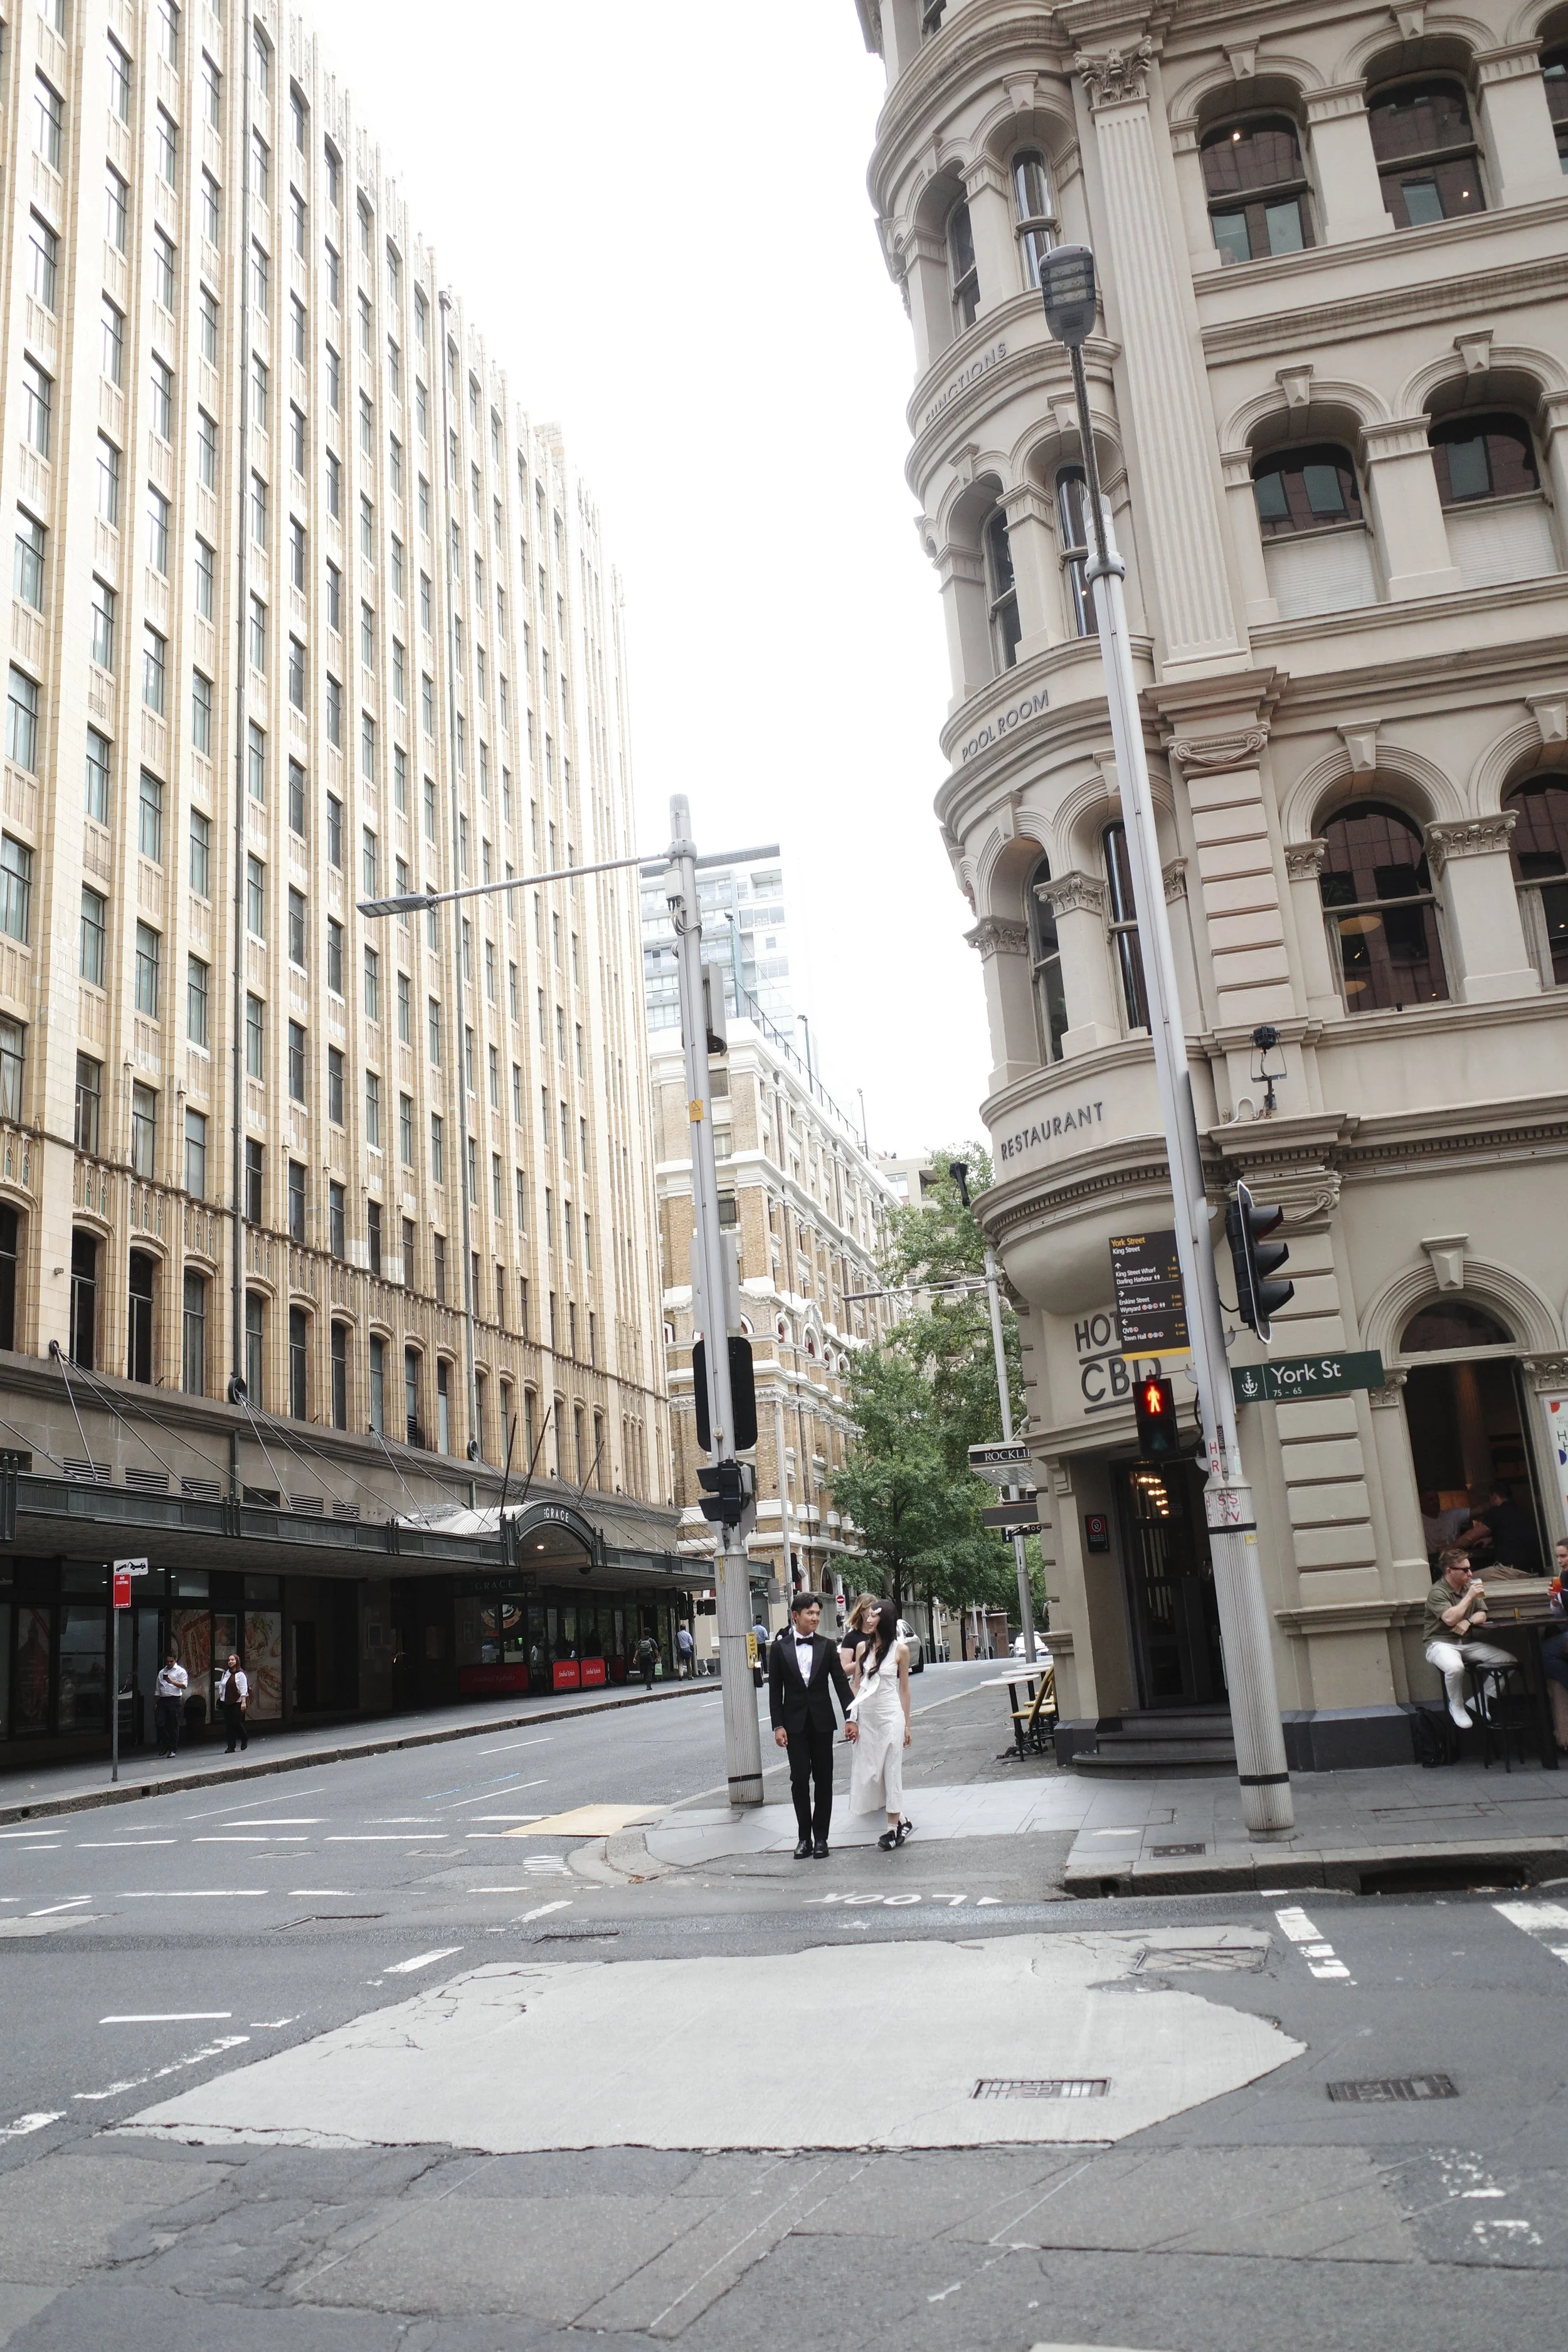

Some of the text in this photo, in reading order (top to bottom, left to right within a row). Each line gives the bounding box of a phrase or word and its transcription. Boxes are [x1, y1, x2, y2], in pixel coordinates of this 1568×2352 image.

[962, 689, 1049, 763] POOL ROOM
[1000, 1101, 1103, 1161] RESTAURANT
[1111, 1237, 1146, 1248] York Street
[1120, 1305, 1141, 1313] Wynyard
[1074, 1311, 1121, 1352] HOT
[1081, 1358, 1162, 1402] CBD
[1270, 1360, 1342, 1384] York St
[546, 1508, 569, 1523] GRACE
[475, 1580, 513, 1591] GRACE
[803, 1892, 968, 1905] LOOK
